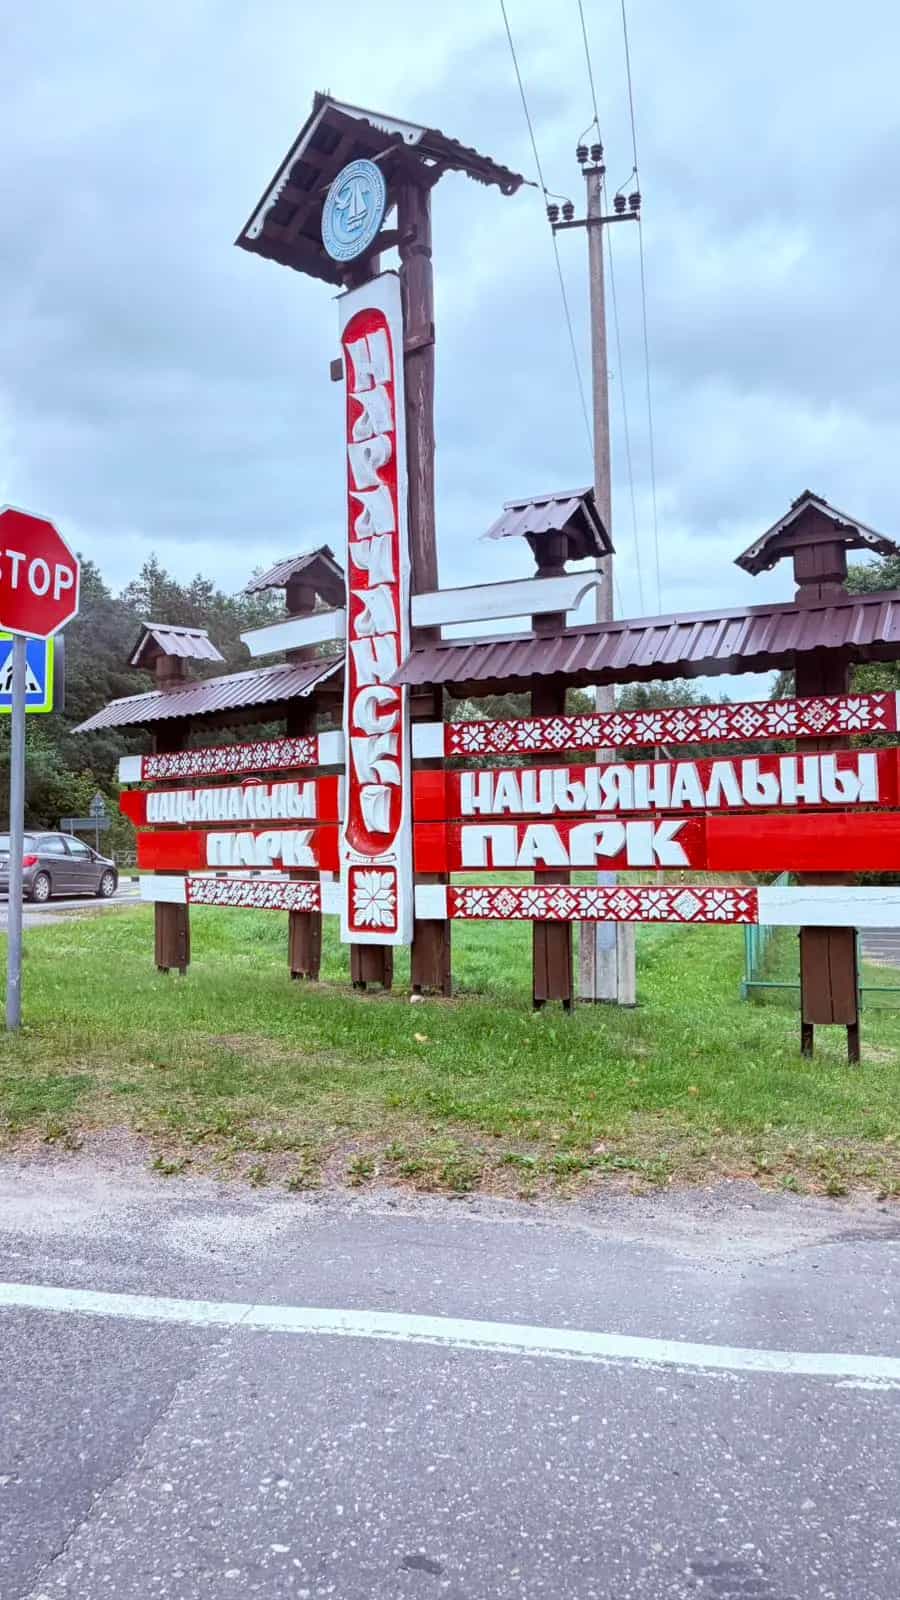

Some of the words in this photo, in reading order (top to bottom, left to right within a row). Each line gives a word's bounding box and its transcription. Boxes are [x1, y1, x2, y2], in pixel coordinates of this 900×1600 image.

[0, 548, 74, 601] TOP
[460, 752, 880, 816] НАЦЫЯНАЛЬНЫ
[206, 828, 320, 868] ПАРК
[460, 820, 691, 867] ПАРК
